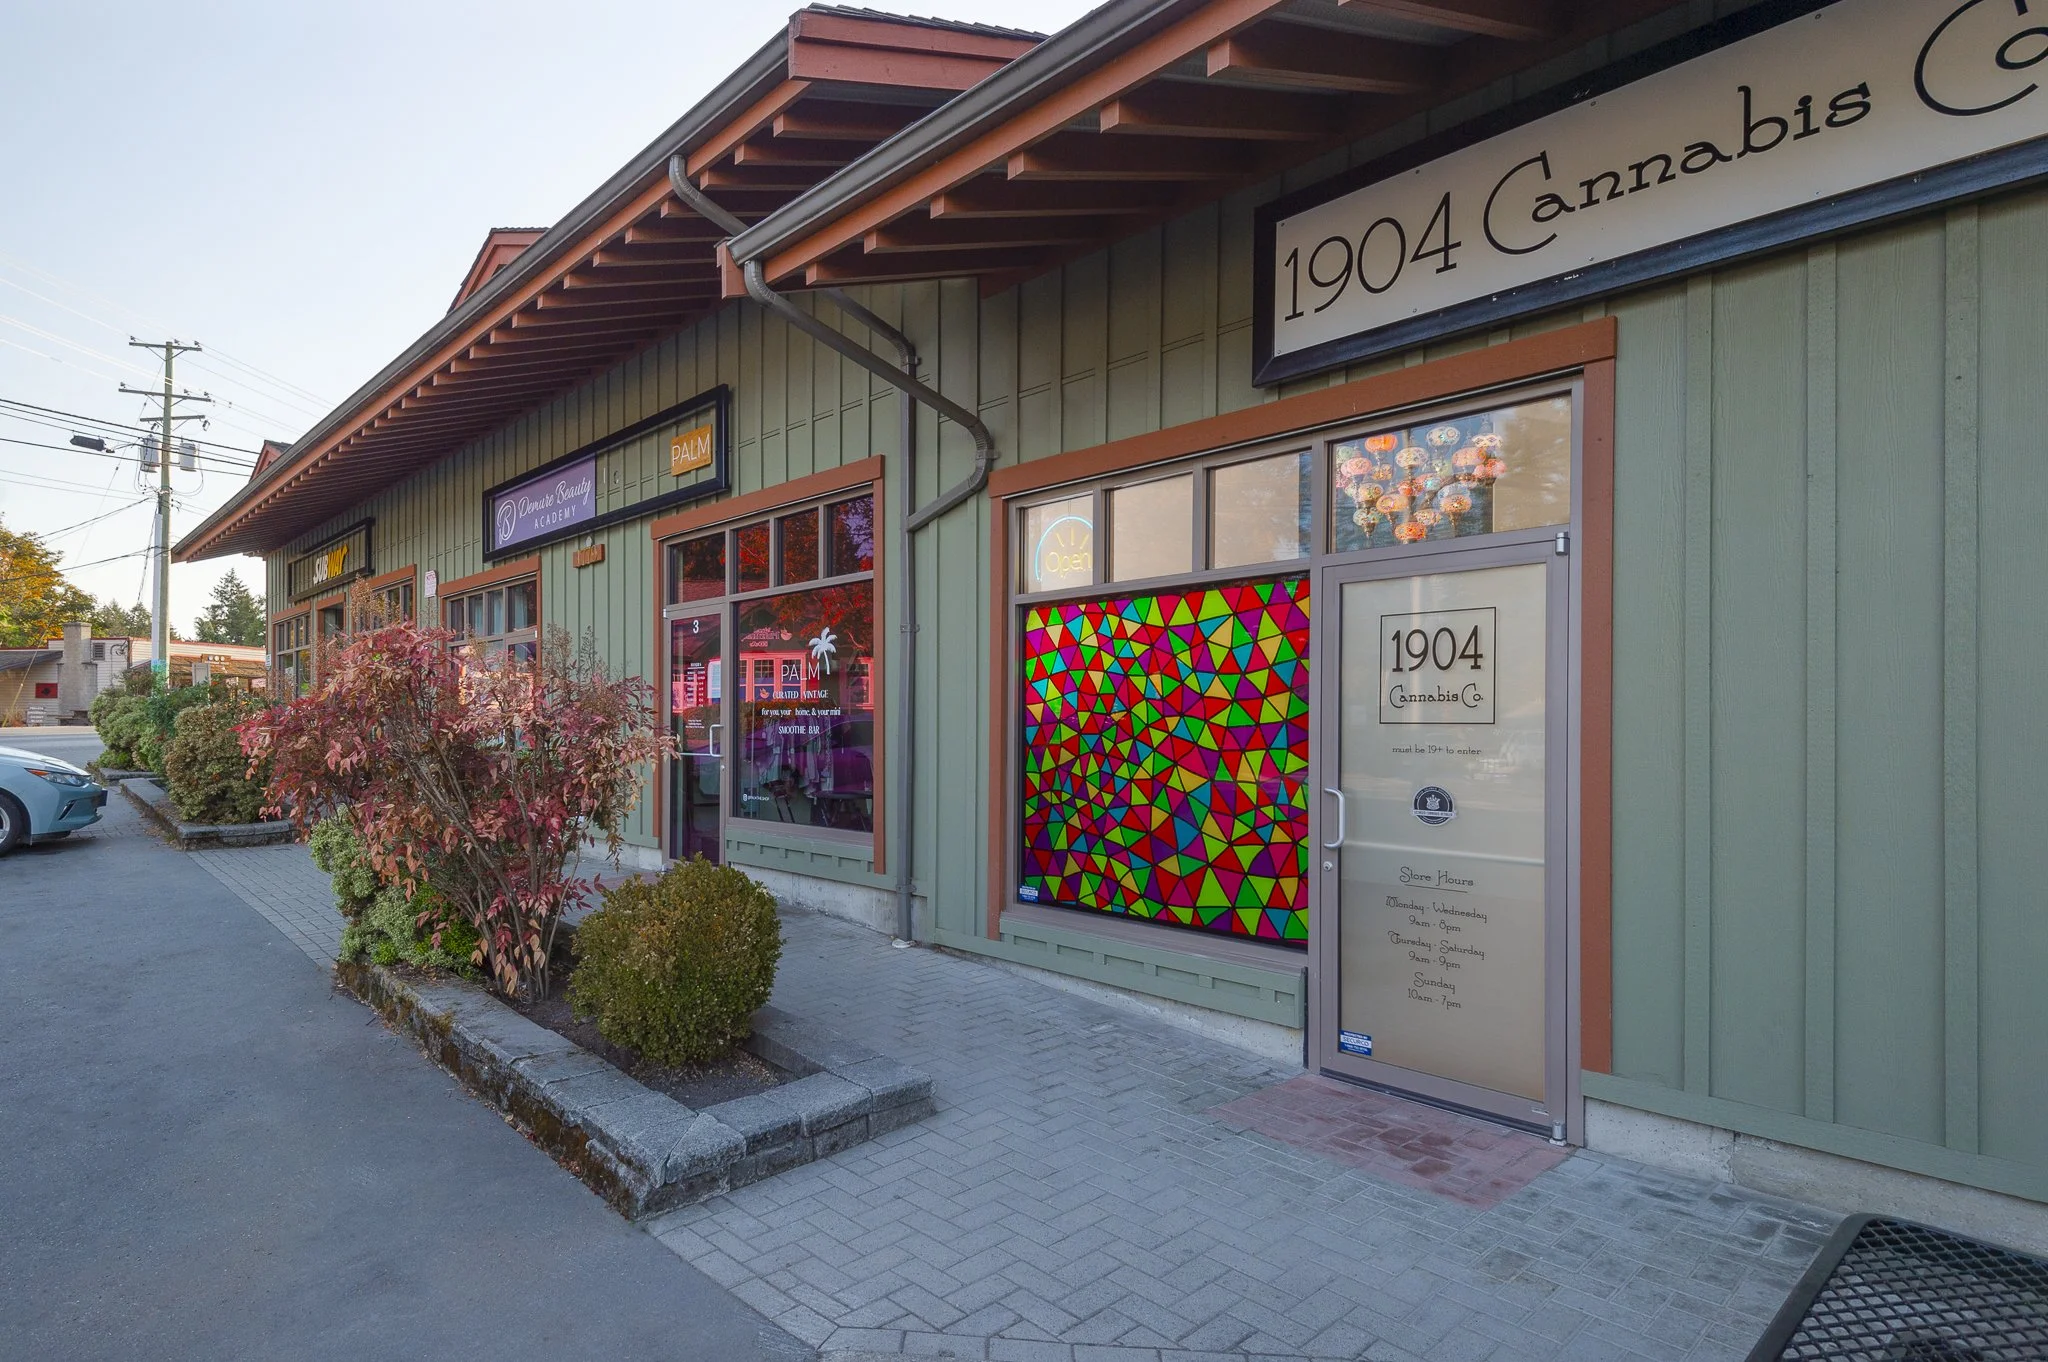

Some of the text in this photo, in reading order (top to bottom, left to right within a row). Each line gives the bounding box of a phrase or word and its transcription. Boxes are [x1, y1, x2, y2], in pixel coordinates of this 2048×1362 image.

[1284, 190, 1462, 322] 1904
[1483, 81, 1872, 255] Cannabis
[671, 433, 710, 467] PALM
[518, 477, 592, 519] Demure Beauty
[534, 504, 577, 530] ACADEMY
[312, 543, 349, 585] SUBWAY
[1045, 551, 1092, 578] Open
[692, 619, 700, 634] 3
[1391, 625, 1484, 672] 1904
[781, 662, 820, 682] PALM
[772, 689, 829, 700] CURATED VINTAGE
[1389, 682, 1484, 708] Cannabis Co.
[761, 707, 769, 716] for
[780, 709, 791, 718] your
[811, 707, 817, 715] &
[817, 708, 830, 718] your
[830, 707, 841, 716] mini
[778, 725, 820, 735] SMOOTHIE BAR
[1391, 743, 1482, 755] must be 19+ to enter
[1399, 866, 1474, 886] Store Hours
[1385, 895, 1424, 915] Monday
[1432, 902, 1488, 924] Wednesday
[1408, 914, 1430, 928] 9am
[1438, 919, 1461, 934] 8pm
[1387, 930, 1432, 952] Thursday
[1439, 939, 1485, 961] Saturday
[1408, 950, 1430, 964] 9am
[1438, 955, 1461, 971] 9pm
[1413, 971, 1456, 995] Sunday
[1407, 987, 1433, 1003] 10am
[1441, 994, 1461, 1010] 7pm
